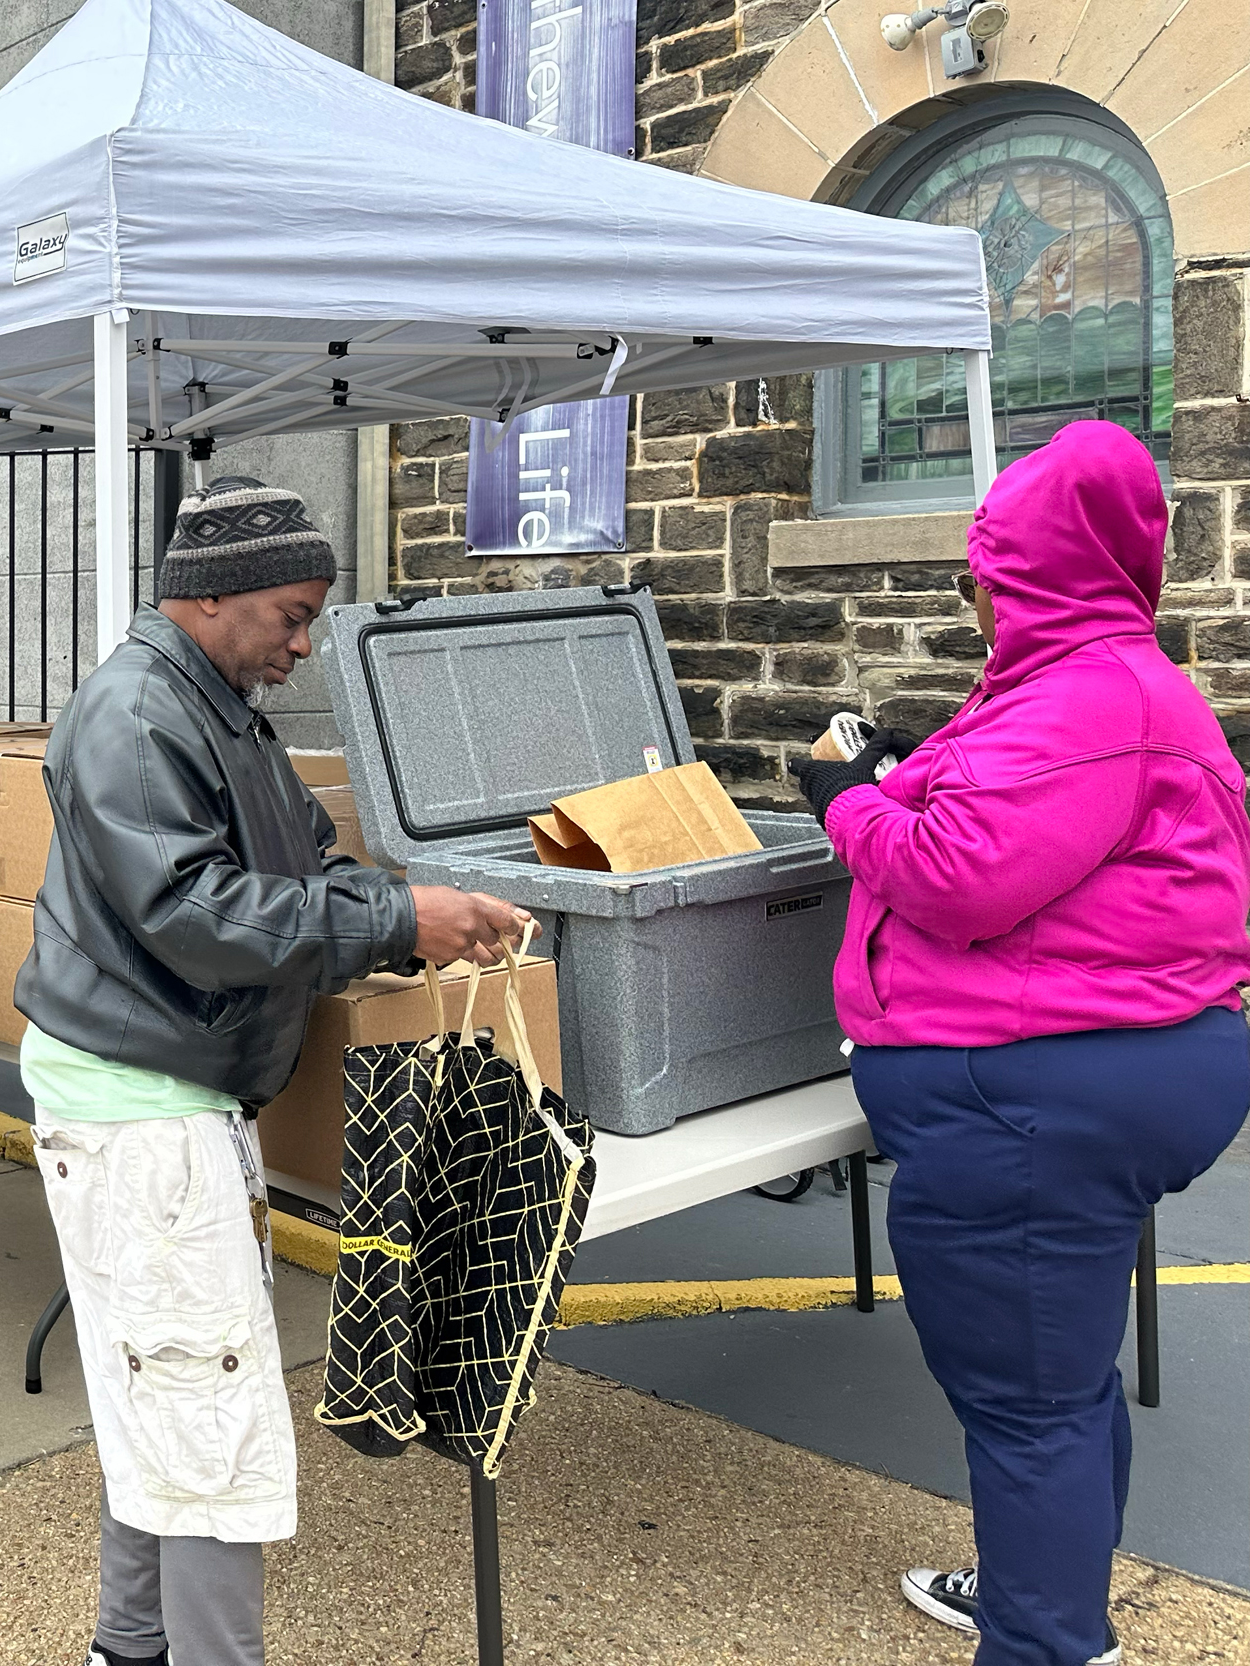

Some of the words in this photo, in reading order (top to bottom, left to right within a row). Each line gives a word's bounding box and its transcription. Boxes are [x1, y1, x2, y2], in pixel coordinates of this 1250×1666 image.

[19, 233, 68, 257] Galaxy
[518, 429, 571, 548] Life
[768, 899, 801, 916] CATER
[802, 897, 820, 907] GATOR
[309, 1211, 338, 1227] LIFETIME
[342, 1239, 375, 1250] DOLLAR
[376, 1238, 411, 1258] GENERAL
